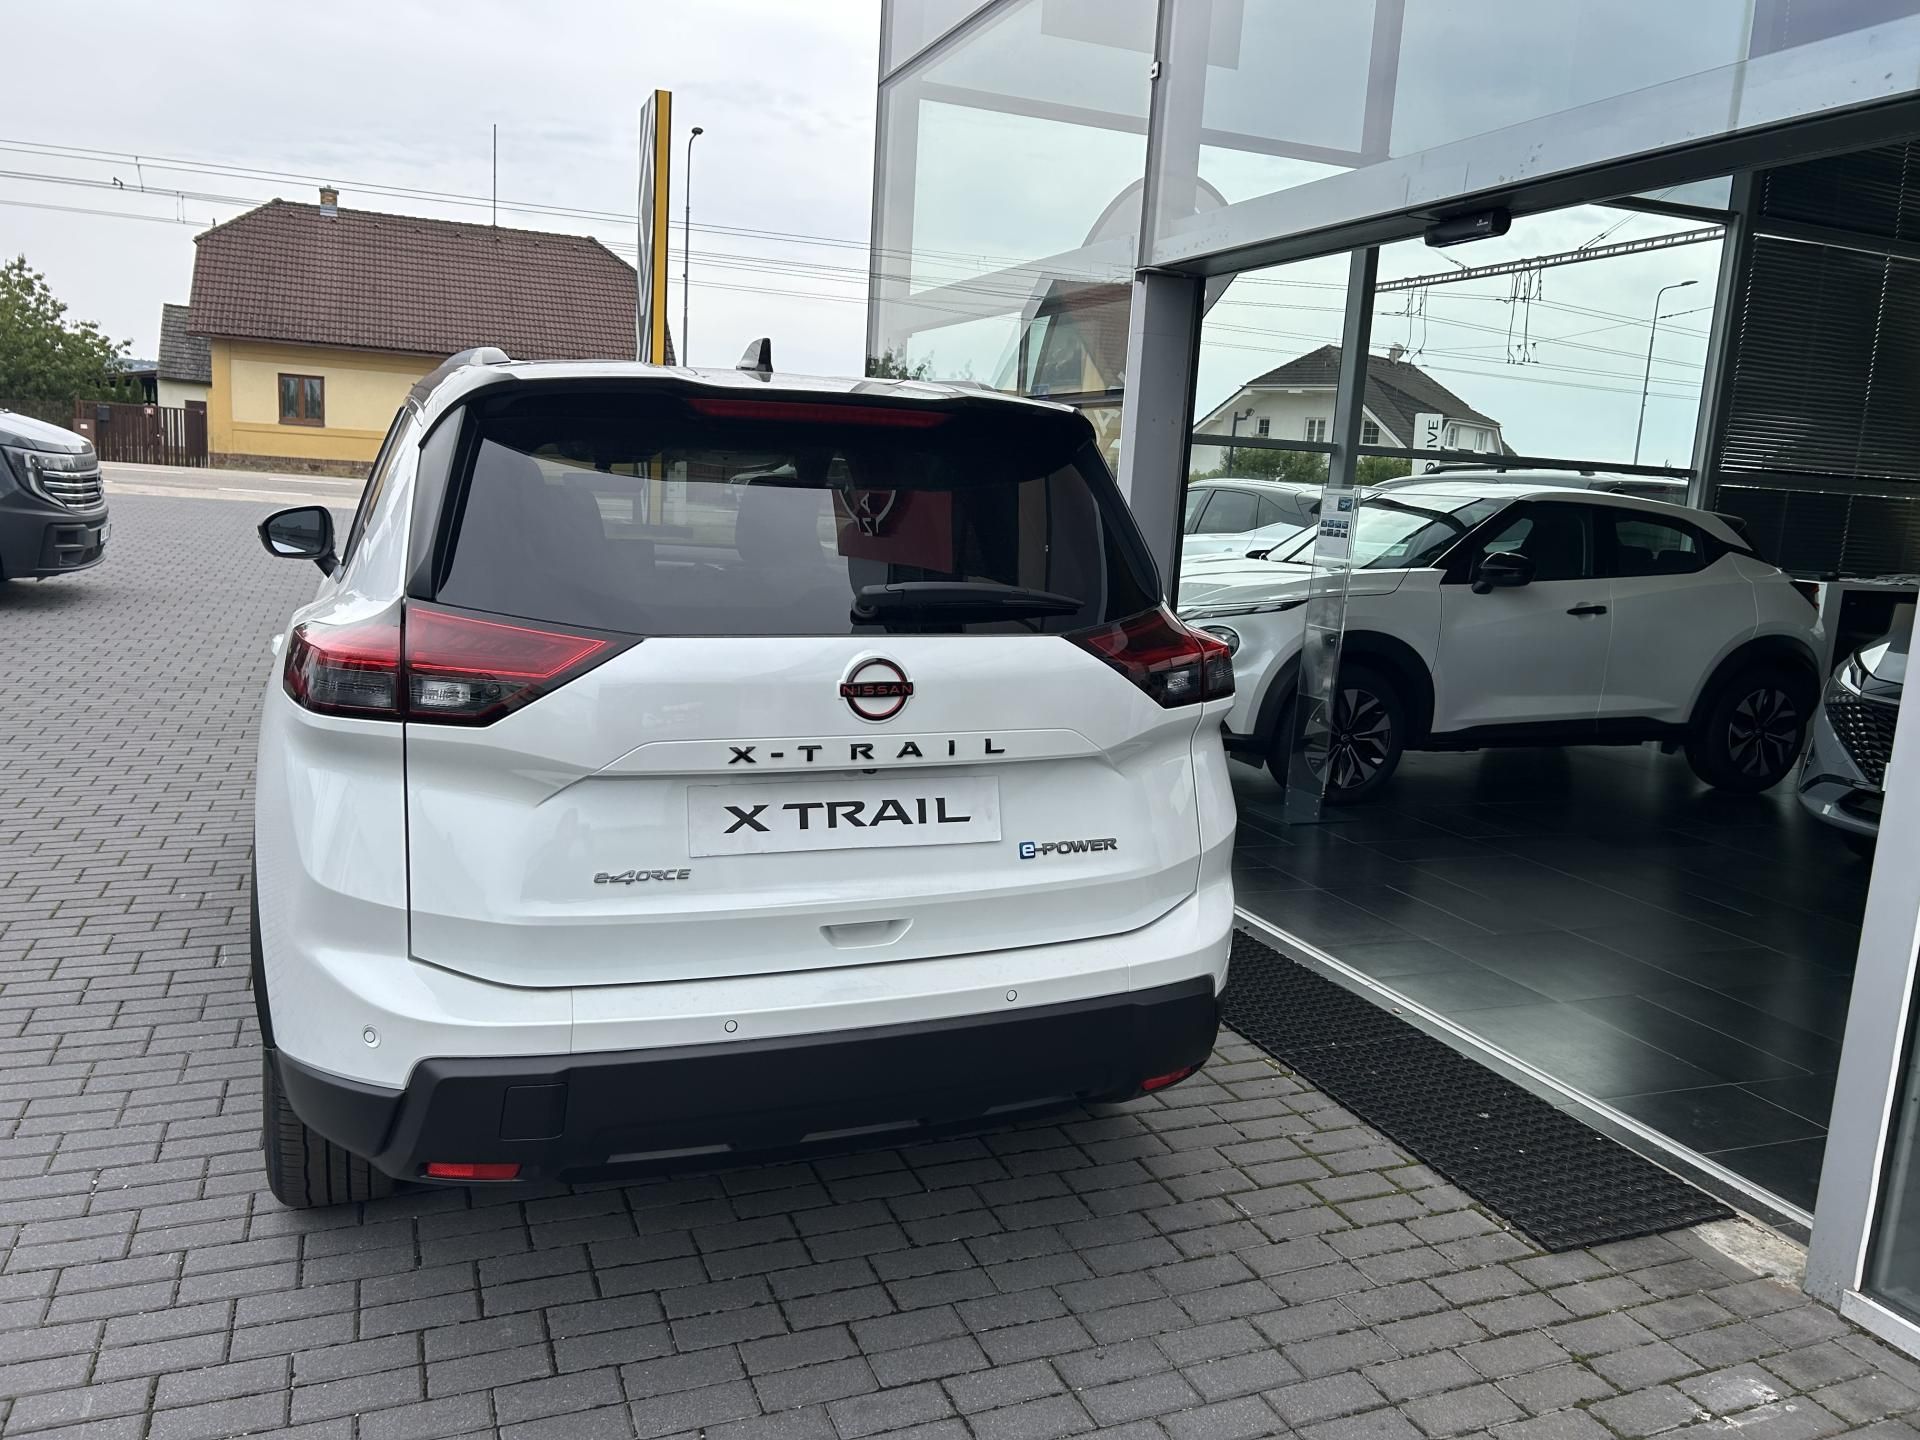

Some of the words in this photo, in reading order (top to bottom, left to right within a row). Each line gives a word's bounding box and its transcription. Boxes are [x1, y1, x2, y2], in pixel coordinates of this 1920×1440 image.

[842, 685, 913, 696] NISSAN
[728, 738, 1006, 764] X-TRAIL
[723, 804, 771, 834] X
[782, 797, 972, 830] TRAIL
[1019, 838, 1118, 859] e-POWER
